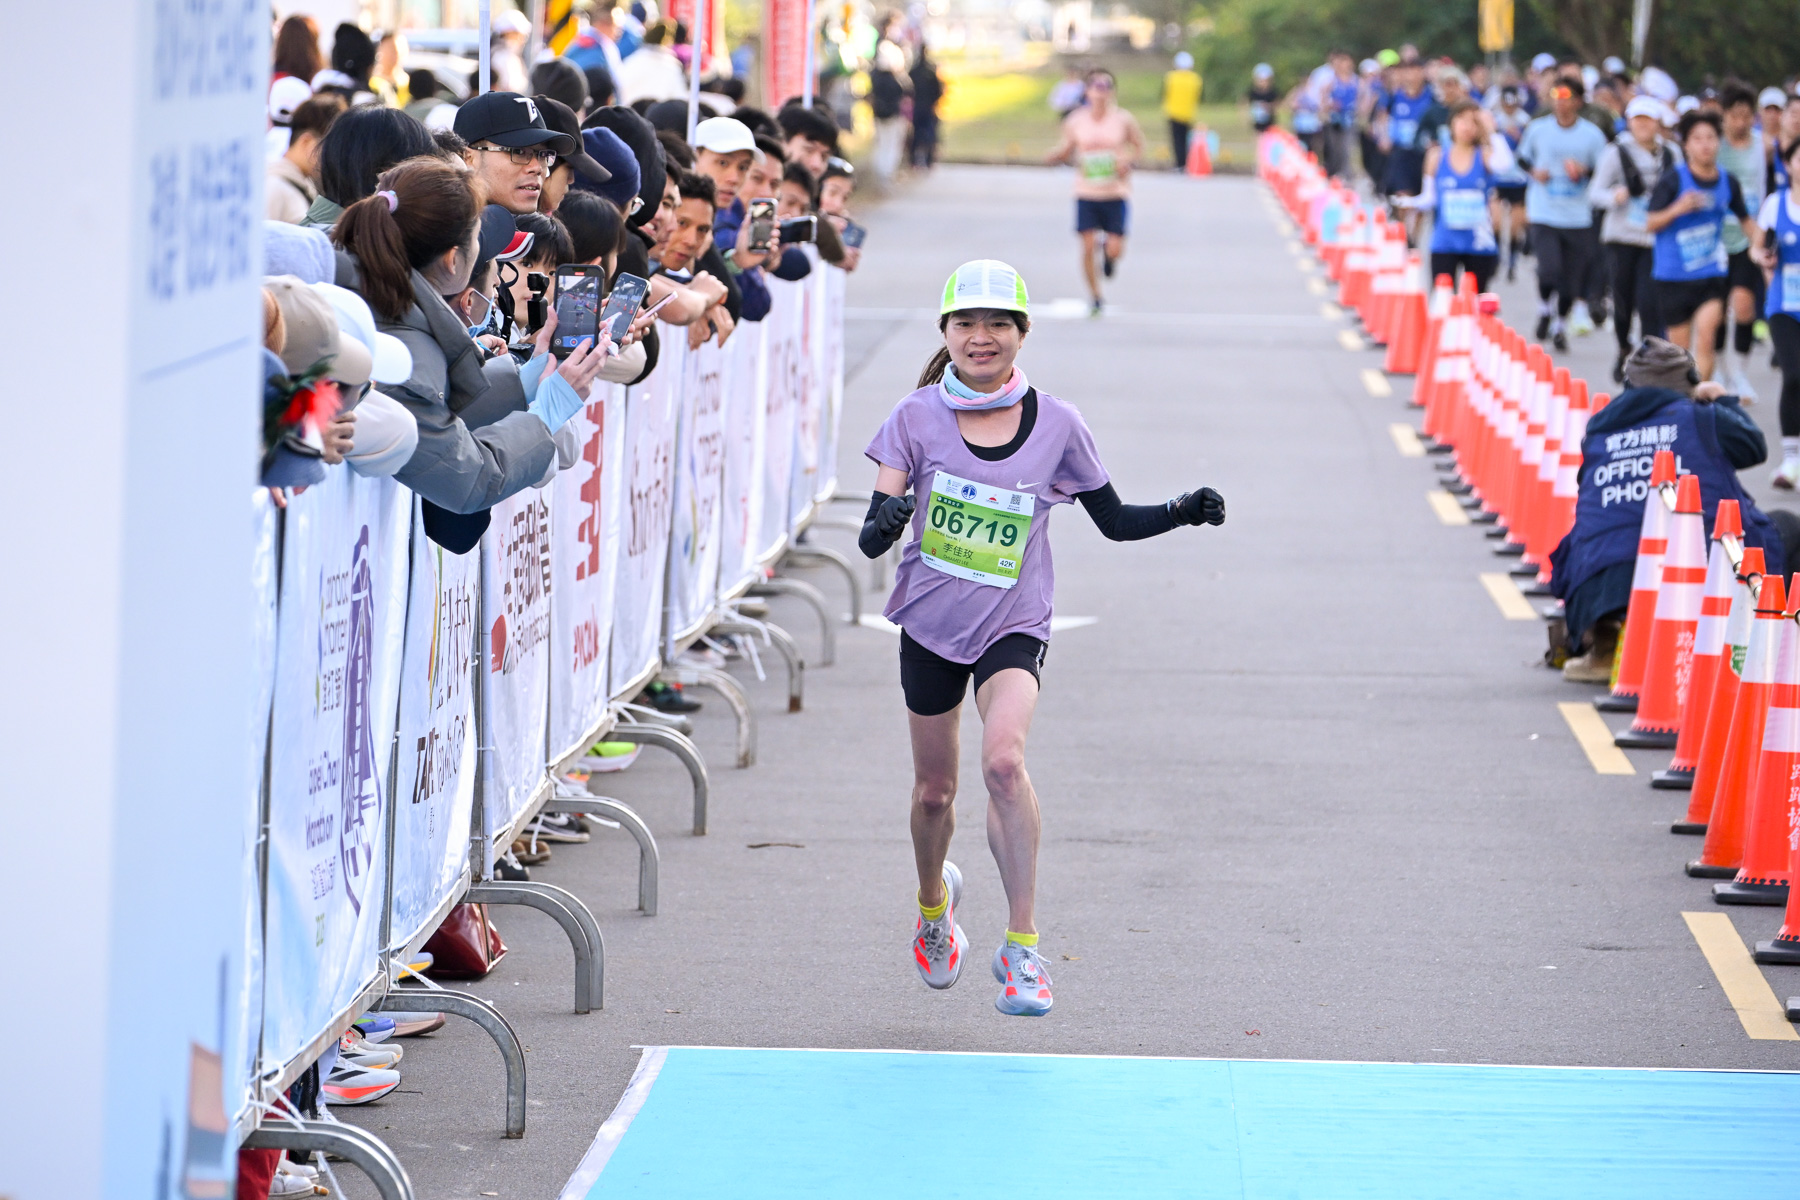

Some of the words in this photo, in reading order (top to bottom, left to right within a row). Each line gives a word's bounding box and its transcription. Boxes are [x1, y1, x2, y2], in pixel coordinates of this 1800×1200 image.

[1594, 454, 1691, 487] OFFICL
[931, 505, 1018, 547] 06719
[943, 542, 974, 560] 李佳玫
[999, 559, 1014, 569] 42K
